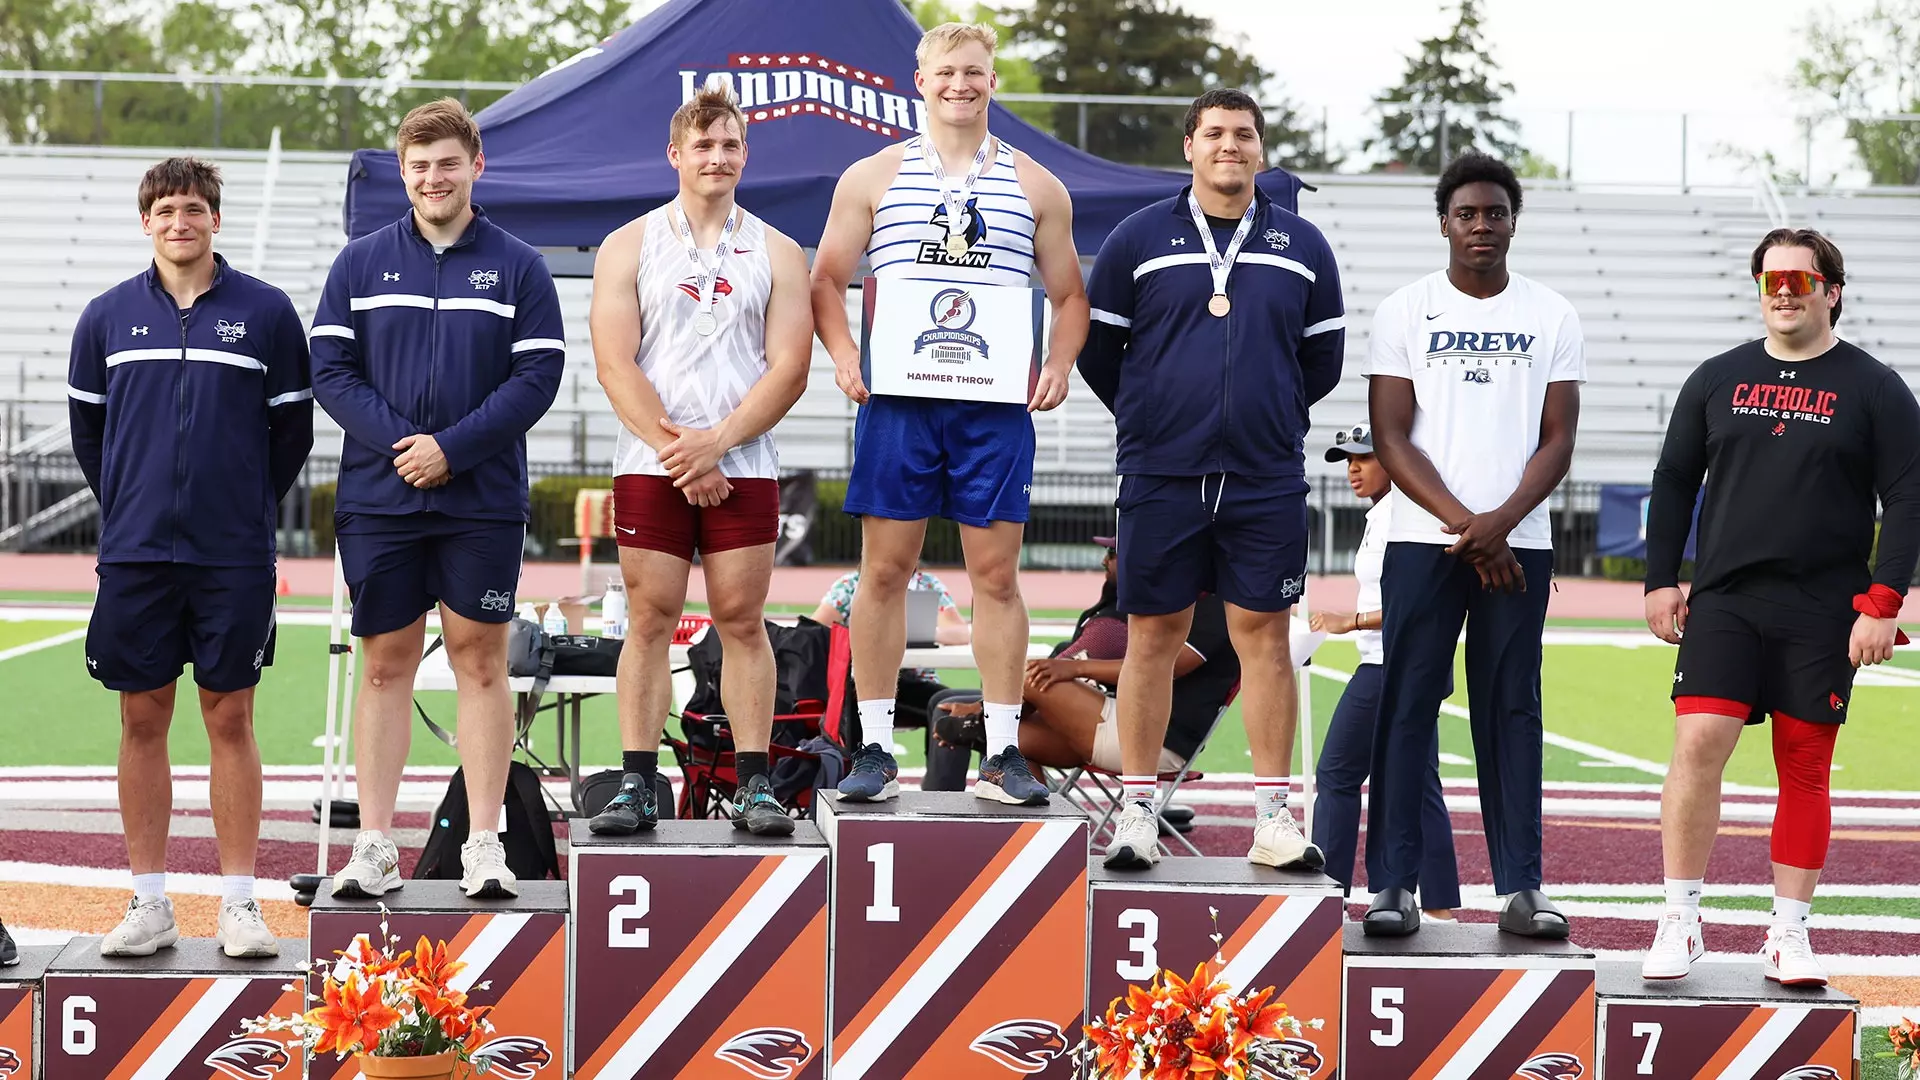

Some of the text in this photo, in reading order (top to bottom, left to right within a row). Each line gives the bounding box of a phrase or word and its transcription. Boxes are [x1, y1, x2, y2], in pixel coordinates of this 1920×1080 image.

[745, 103, 891, 136] ONFERENCE
[922, 332, 981, 346] CHAMPIONSHIPS
[931, 348, 971, 361] LANDMARK
[1426, 331, 1536, 353] DREW
[907, 372, 994, 385] HAMMER THROW
[1427, 359, 1532, 368] RANGERS
[1731, 407, 1831, 425] TRACK & FIELD
[1732, 383, 1837, 416] CATHOLIC
[866, 843, 900, 921] 1
[608, 875, 650, 947] 2
[1116, 908, 1159, 980] 3
[62, 996, 96, 1055] 6
[1370, 987, 1404, 1046] 5
[1632, 1022, 1663, 1075] 7
